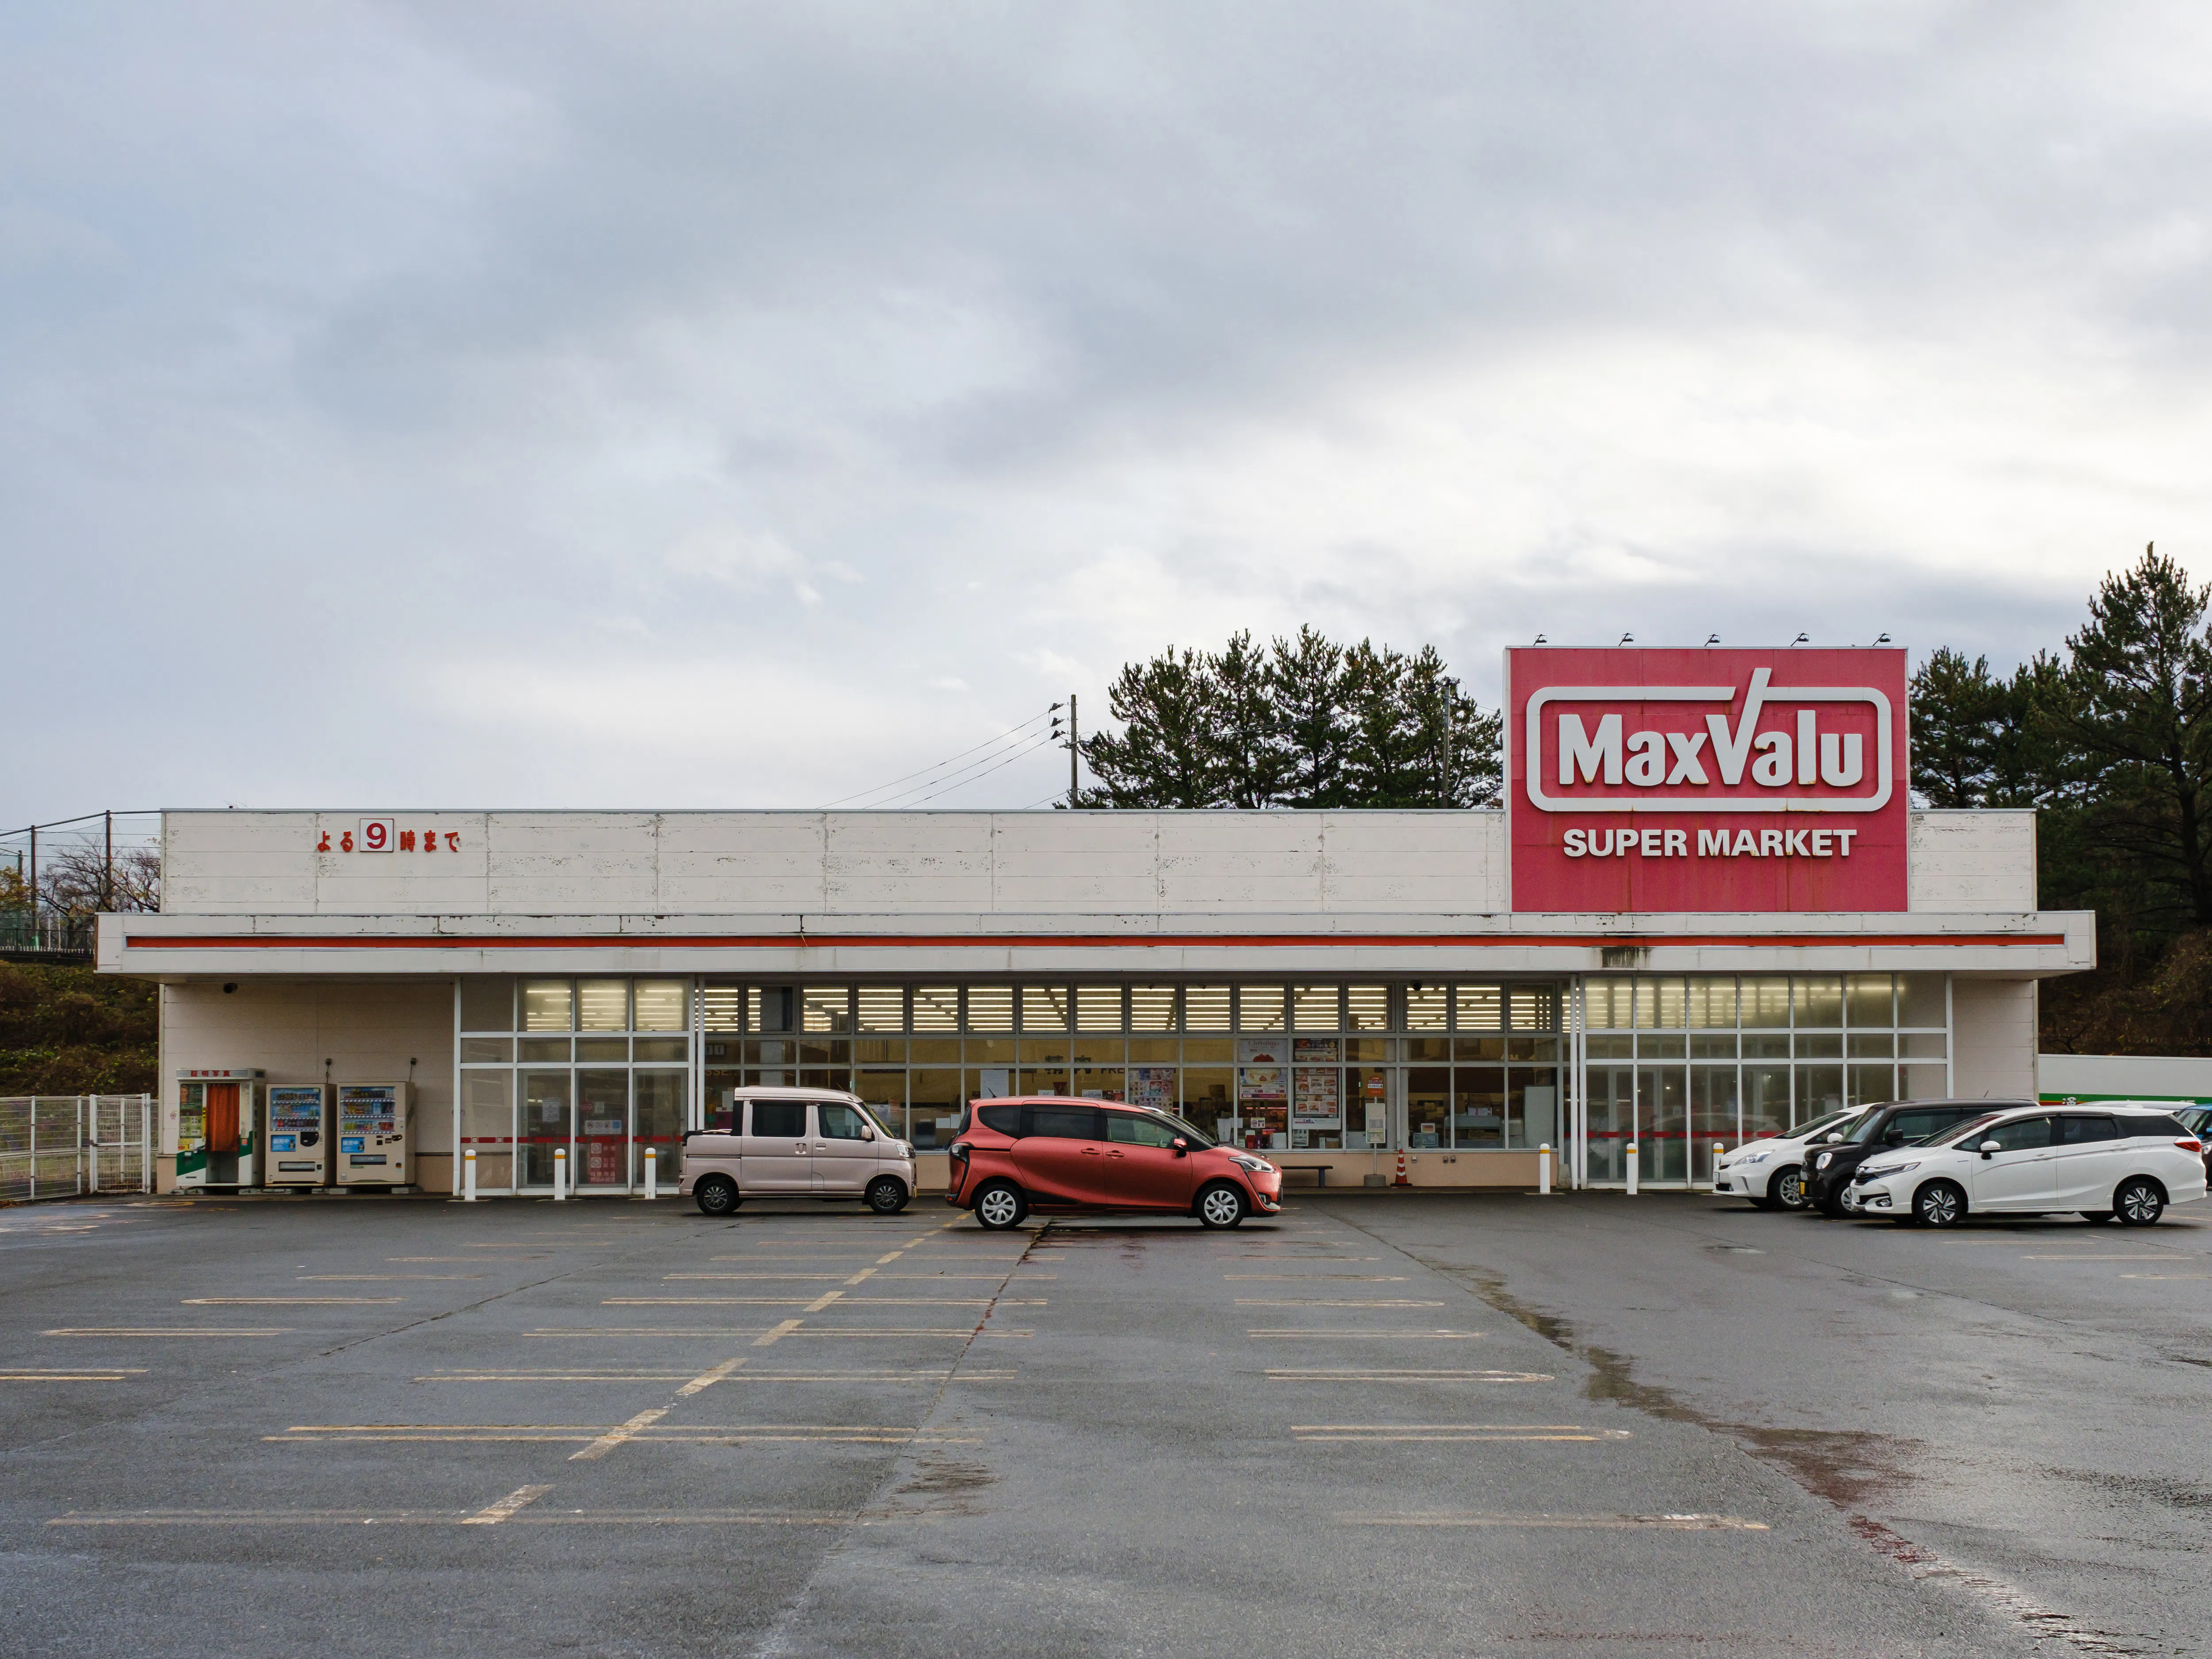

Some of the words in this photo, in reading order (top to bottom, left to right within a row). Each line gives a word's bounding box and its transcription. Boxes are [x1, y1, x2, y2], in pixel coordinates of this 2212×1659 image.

[1559, 668, 1863, 787] MaxValu
[1563, 829, 1687, 857] SUPER
[1698, 829, 1857, 856] MARKET
